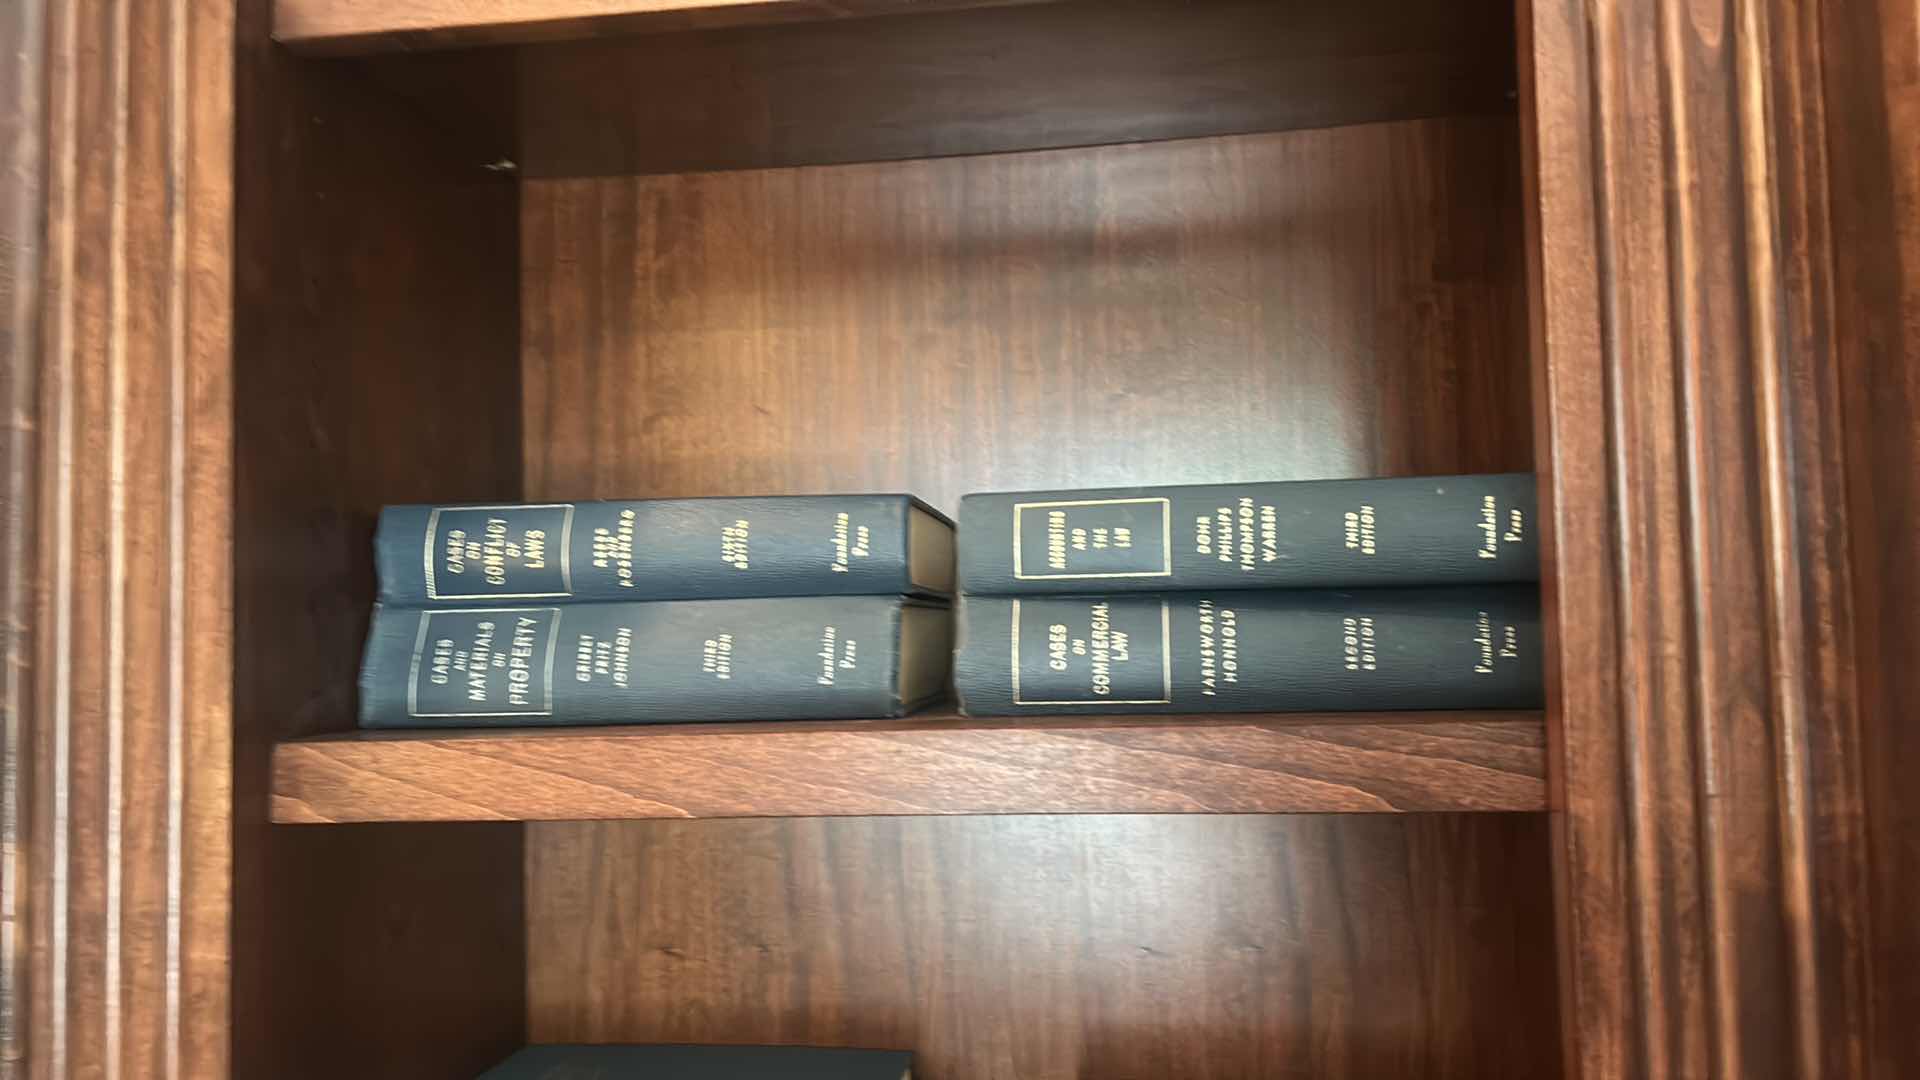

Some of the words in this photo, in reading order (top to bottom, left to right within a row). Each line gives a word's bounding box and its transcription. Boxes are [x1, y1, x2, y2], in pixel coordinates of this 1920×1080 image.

[484, 518, 507, 585] CONFLICT
[524, 530, 545, 568] LAWS
[1072, 528, 1087, 550] AND
[1239, 498, 1255, 570] THOMPSON
[1261, 505, 1277, 562] WARREN
[1345, 512, 1359, 549] THIRD
[468, 622, 496, 701] MATERIALS
[509, 617, 539, 705] PROPERTY
[1049, 624, 1067, 671] CASES
[1072, 639, 1086, 655] ON
[1091, 602, 1110, 695] COMMERCIAL
[1111, 631, 1129, 661] LAW
[1220, 610, 1238, 682] HONNOLD
